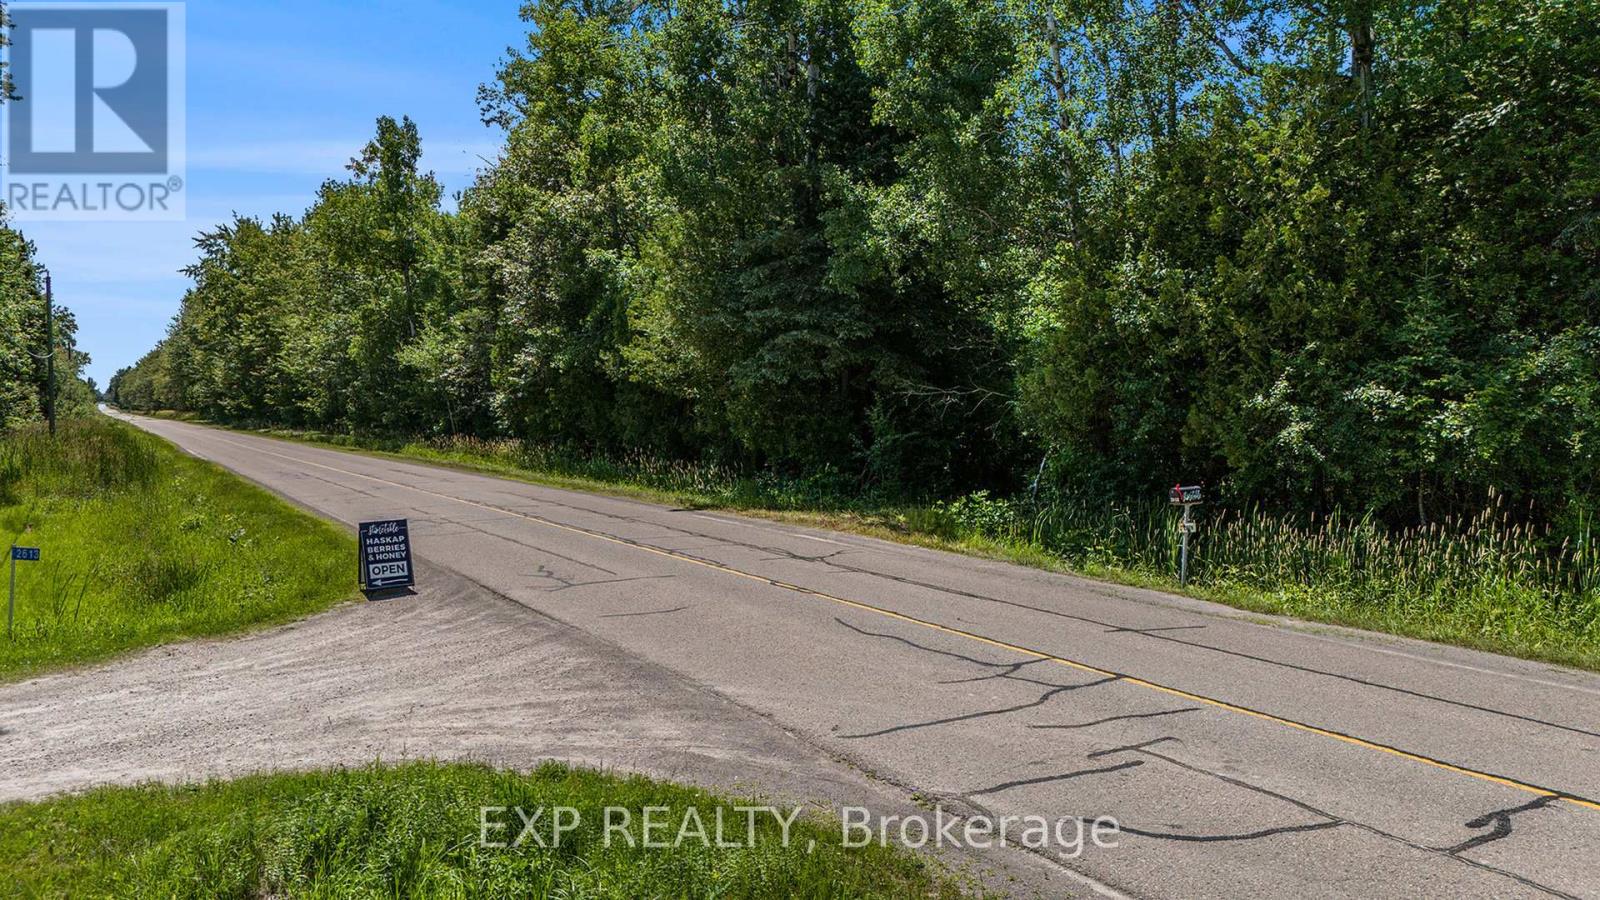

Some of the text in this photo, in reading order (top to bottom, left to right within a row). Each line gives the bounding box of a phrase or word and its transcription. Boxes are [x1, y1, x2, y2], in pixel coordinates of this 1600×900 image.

[366, 535, 405, 545] HASKAP
[367, 543, 406, 554] BERRIES
[376, 551, 407, 560] HONEY
[372, 564, 405, 576] OPEN
